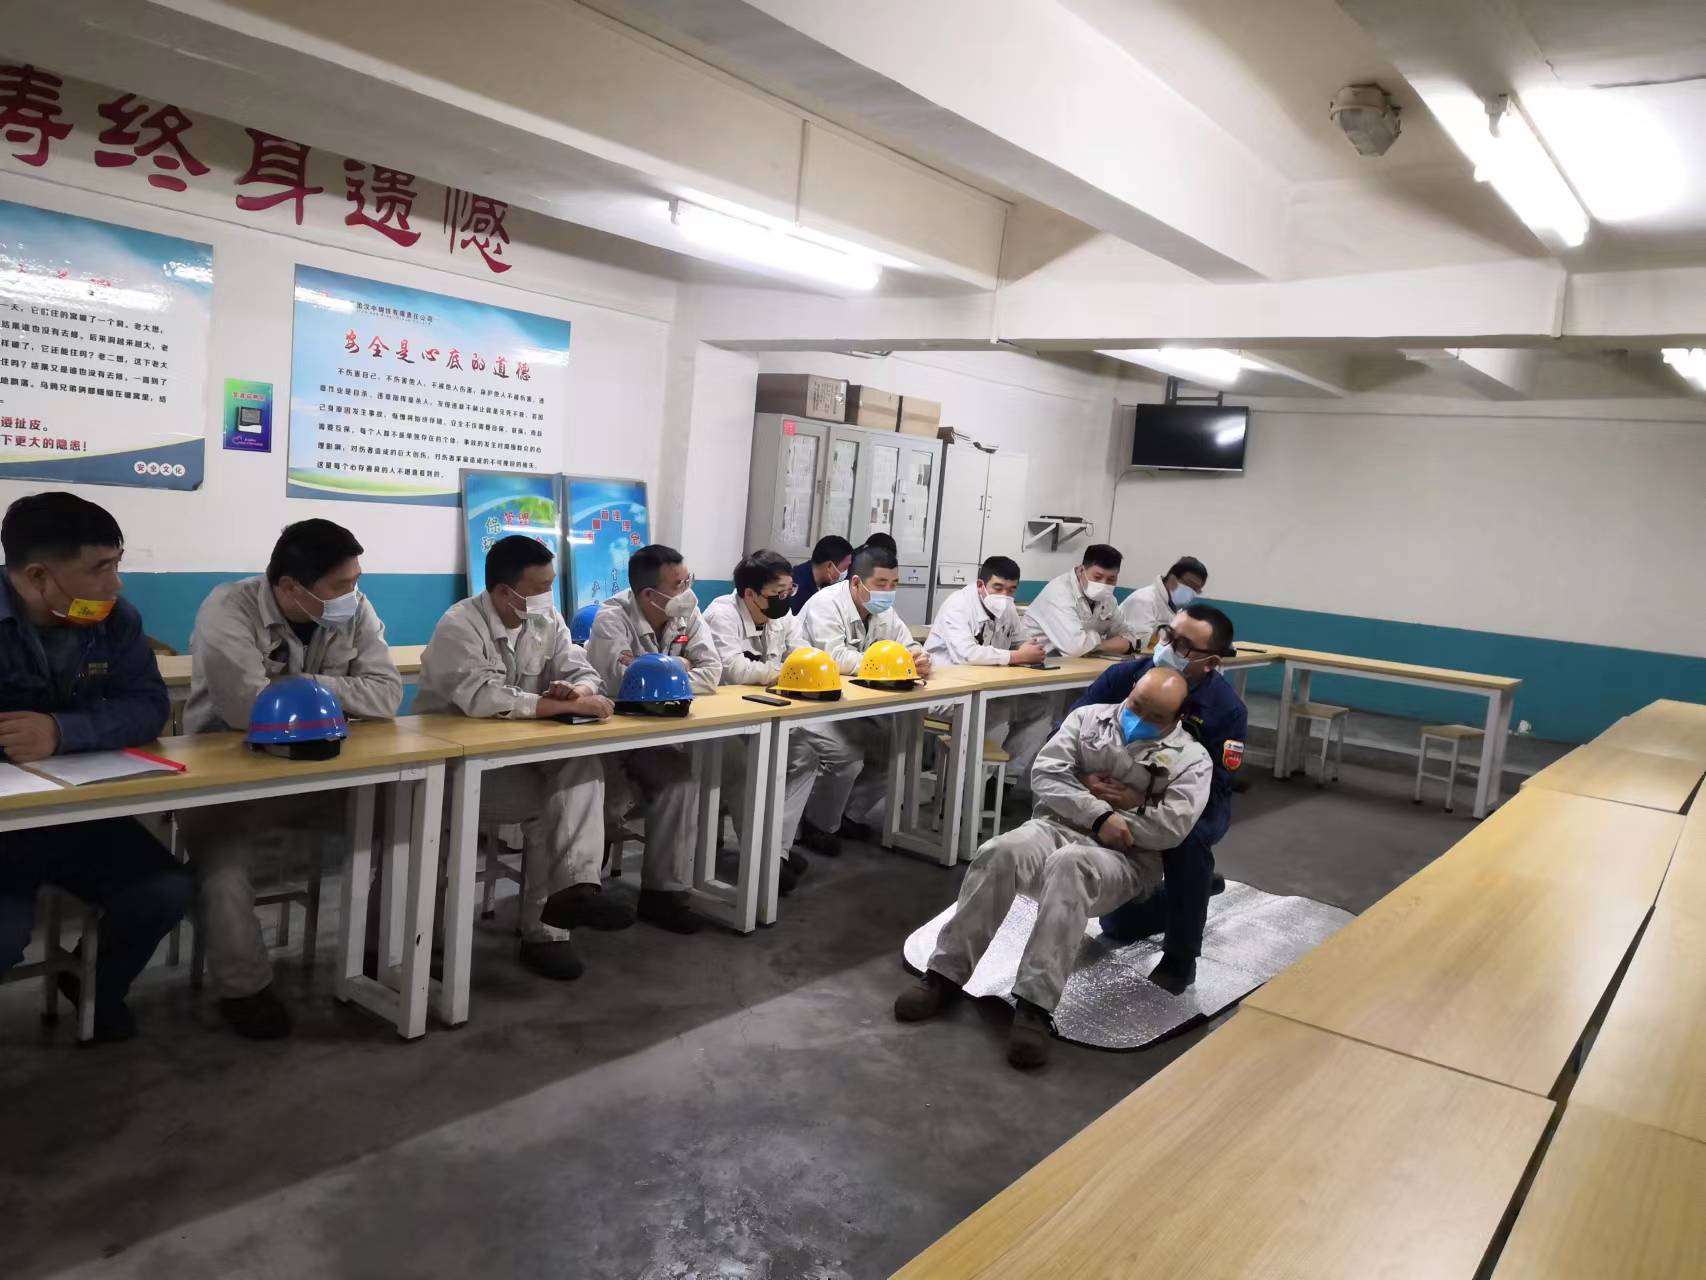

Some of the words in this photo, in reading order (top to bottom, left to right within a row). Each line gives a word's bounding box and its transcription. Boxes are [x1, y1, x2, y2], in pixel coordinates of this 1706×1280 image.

[344, 329, 531, 382] 安全是心底的道德
[135, 462, 184, 476] 安全文化
